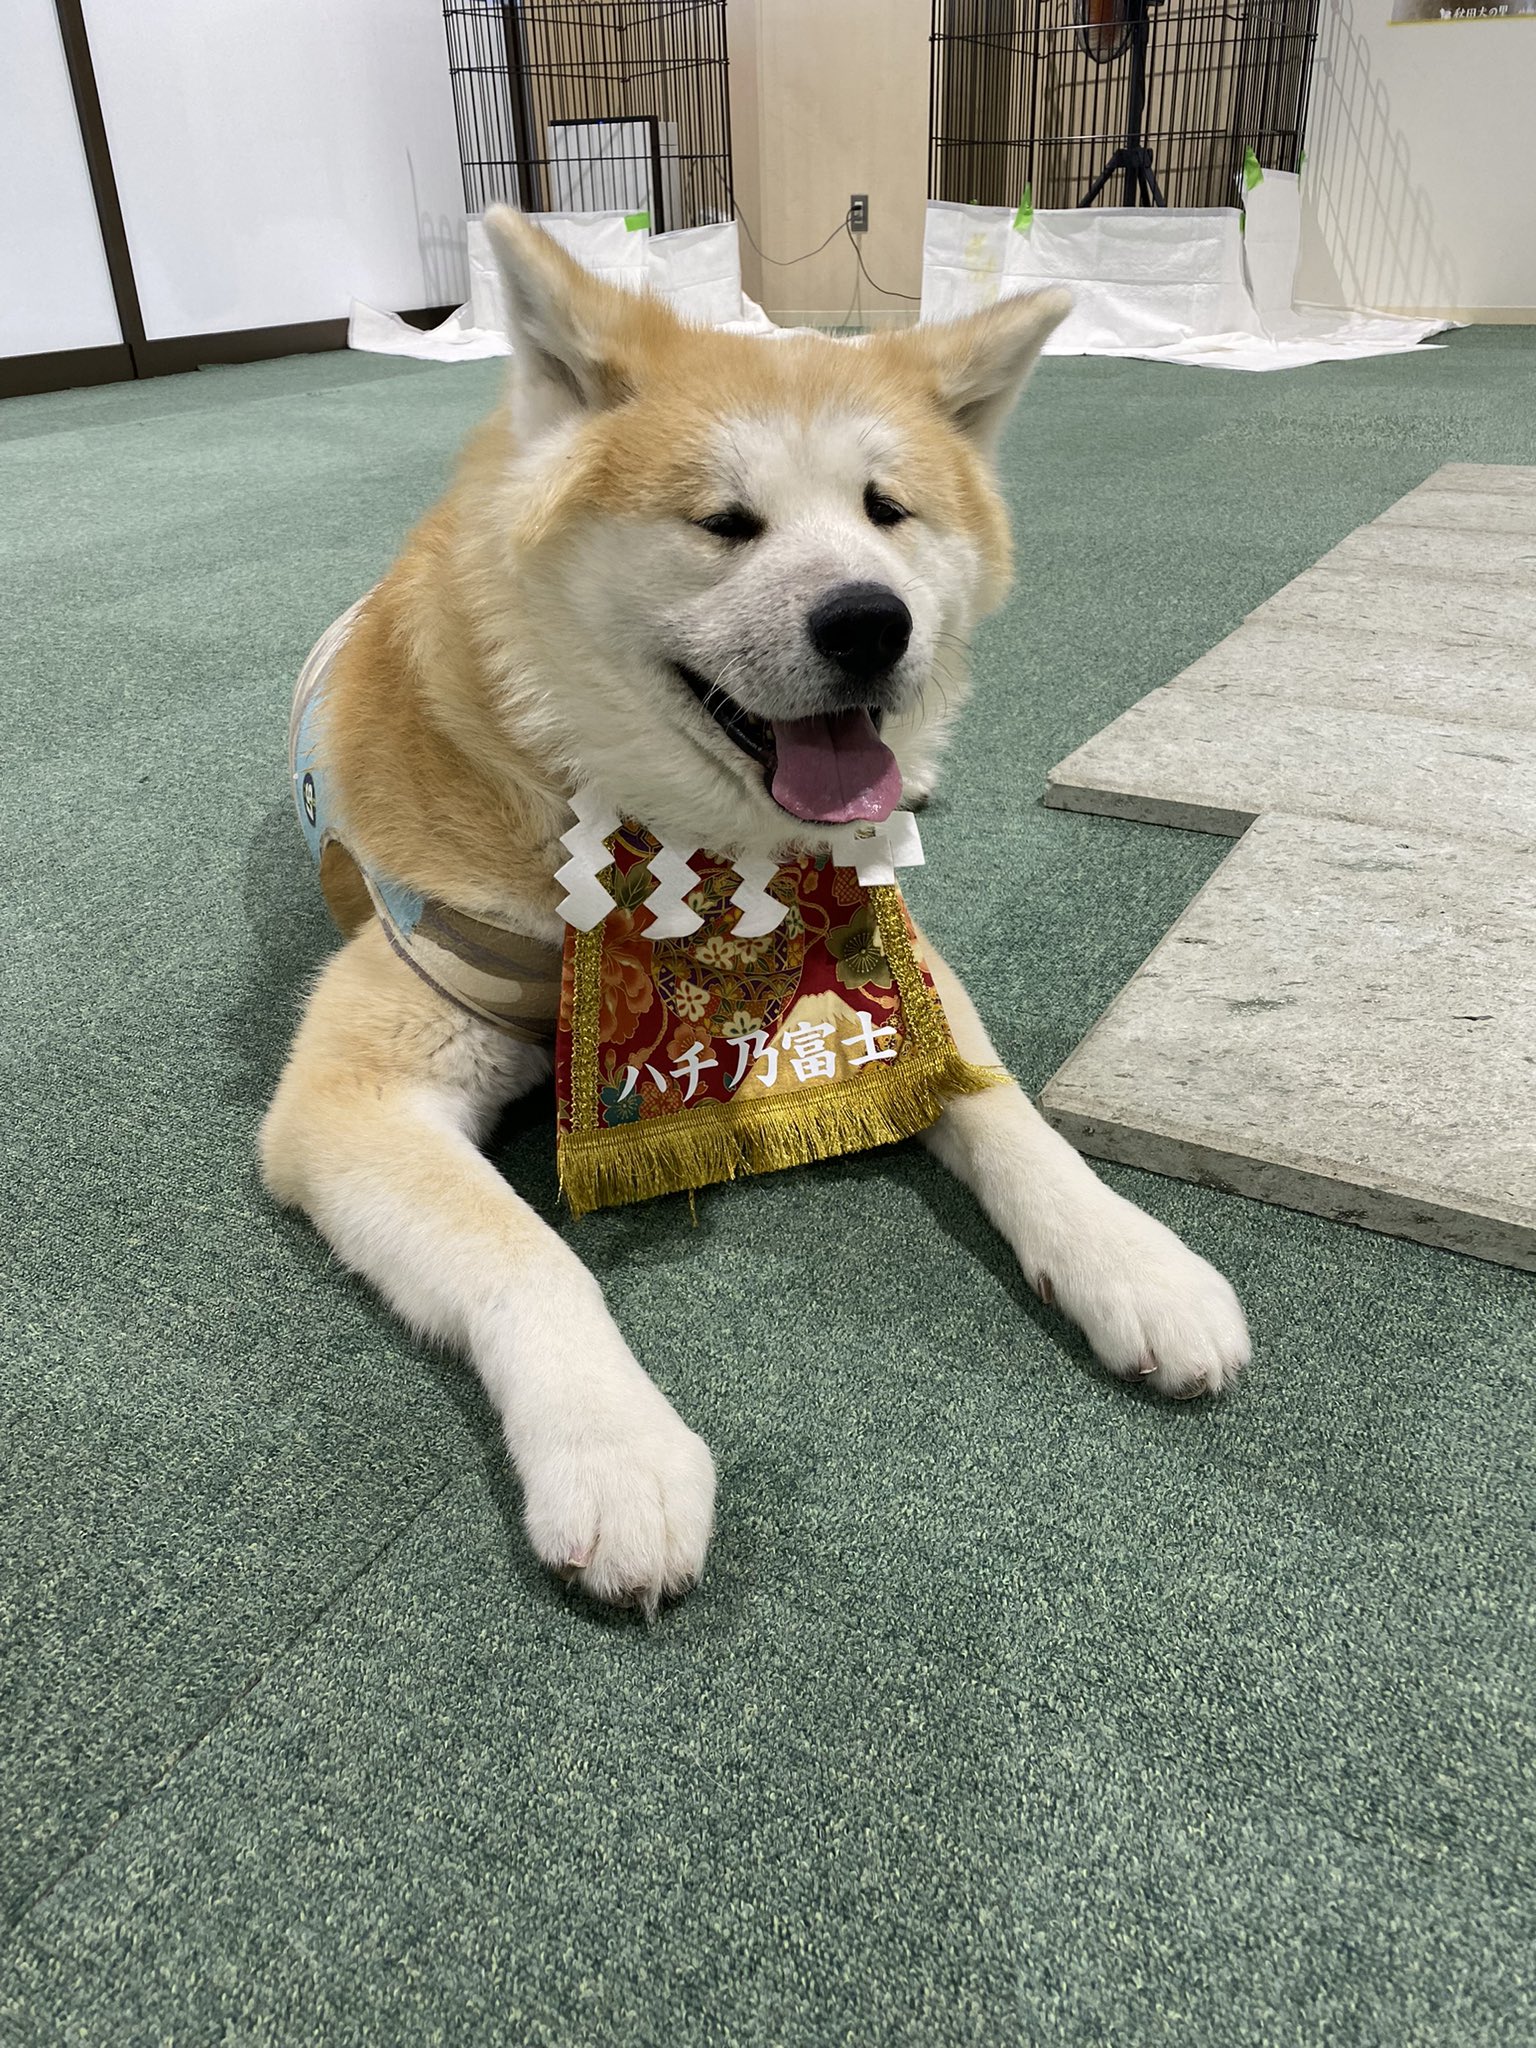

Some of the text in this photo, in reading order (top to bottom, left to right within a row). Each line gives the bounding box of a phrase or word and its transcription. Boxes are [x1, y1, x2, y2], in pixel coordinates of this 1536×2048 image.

[617, 1011, 897, 1102] ハチ乃富士
